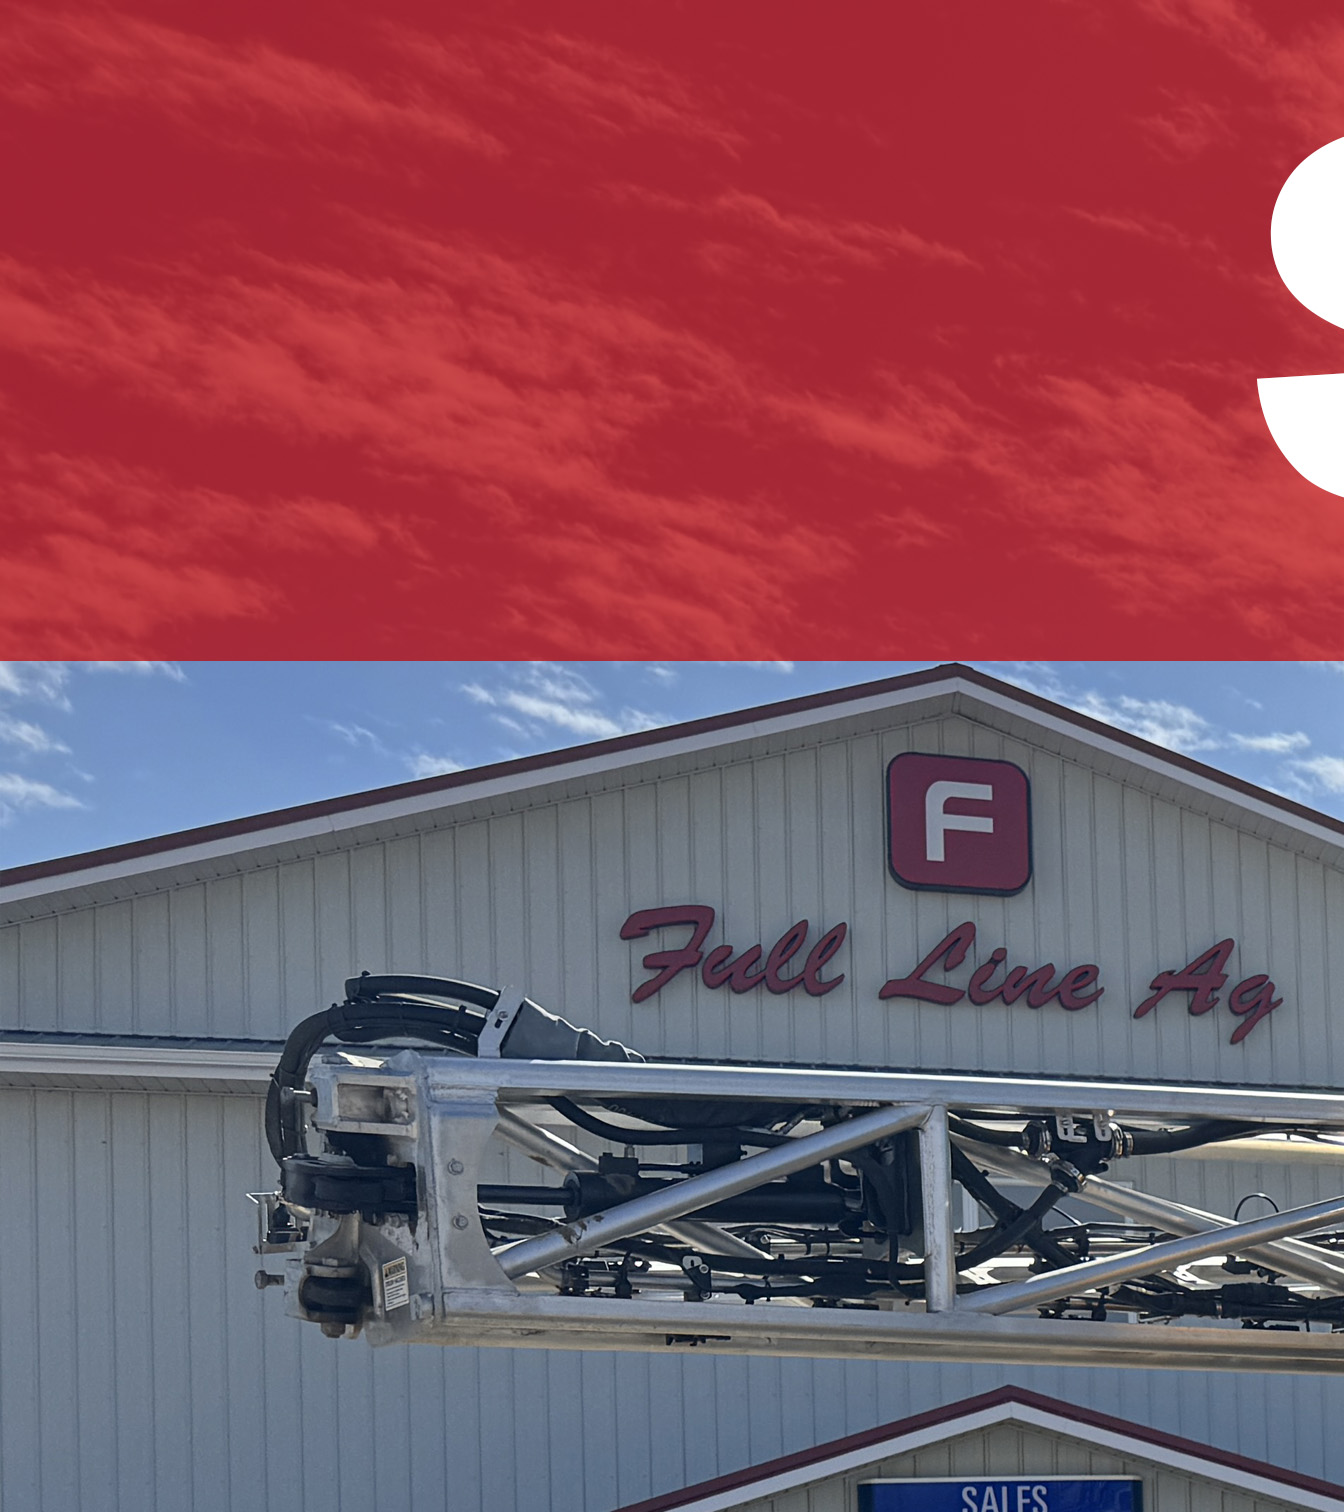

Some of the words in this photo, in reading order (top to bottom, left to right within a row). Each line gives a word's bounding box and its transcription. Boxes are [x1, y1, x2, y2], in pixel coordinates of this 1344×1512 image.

[925, 780, 993, 862] F
[619, 904, 848, 1003] Full
[878, 921, 1104, 1011] Line
[1133, 938, 1283, 1045] Ag
